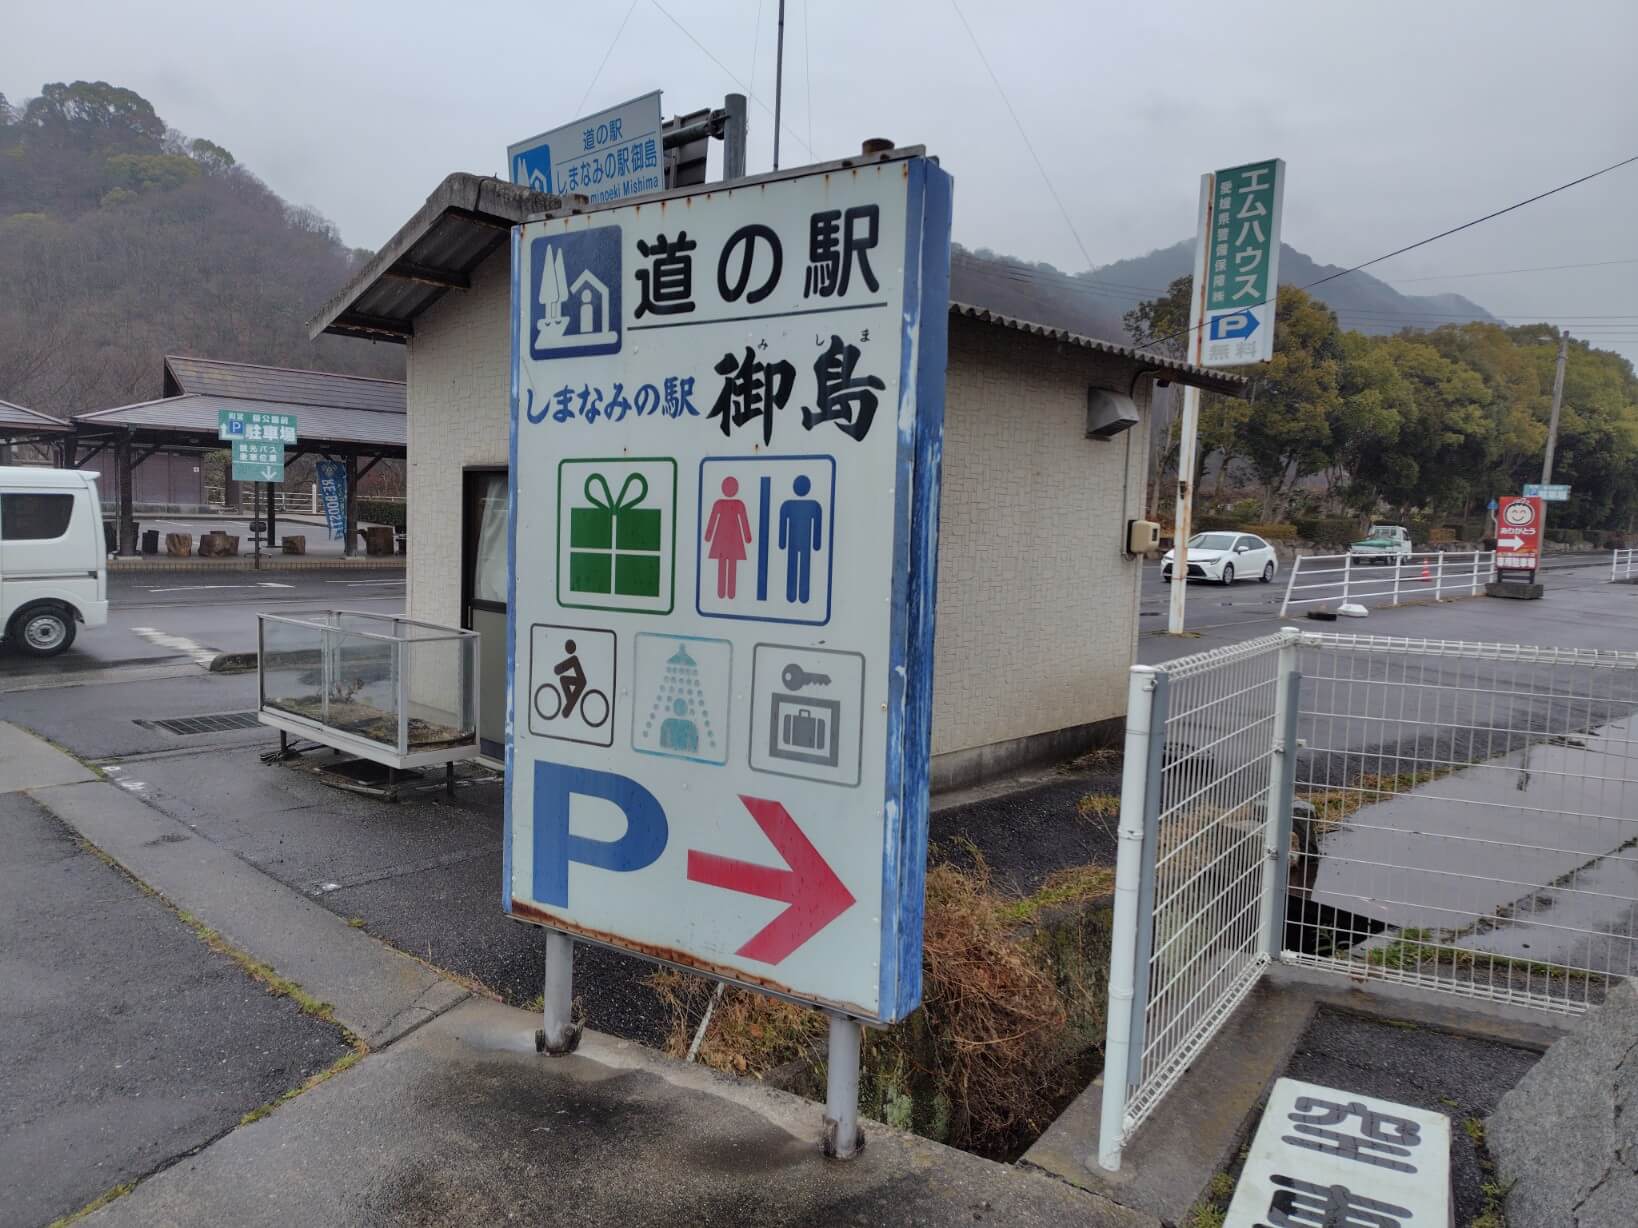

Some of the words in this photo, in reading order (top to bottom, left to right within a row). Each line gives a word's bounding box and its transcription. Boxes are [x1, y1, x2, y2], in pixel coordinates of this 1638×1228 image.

[583, 118, 622, 151] 道の駅
[556, 139, 657, 196] しまなみの駅御島
[623, 175, 659, 196] Mishima
[634, 203, 880, 320] 道の駅
[1232, 168, 1270, 300] エムハウス
[757, 338, 768, 350] み
[526, 376, 700, 424] しまなみの駅
[706, 335, 887, 447] 御島
[245, 423, 296, 442] 駐車場
[532, 760, 669, 909] P
